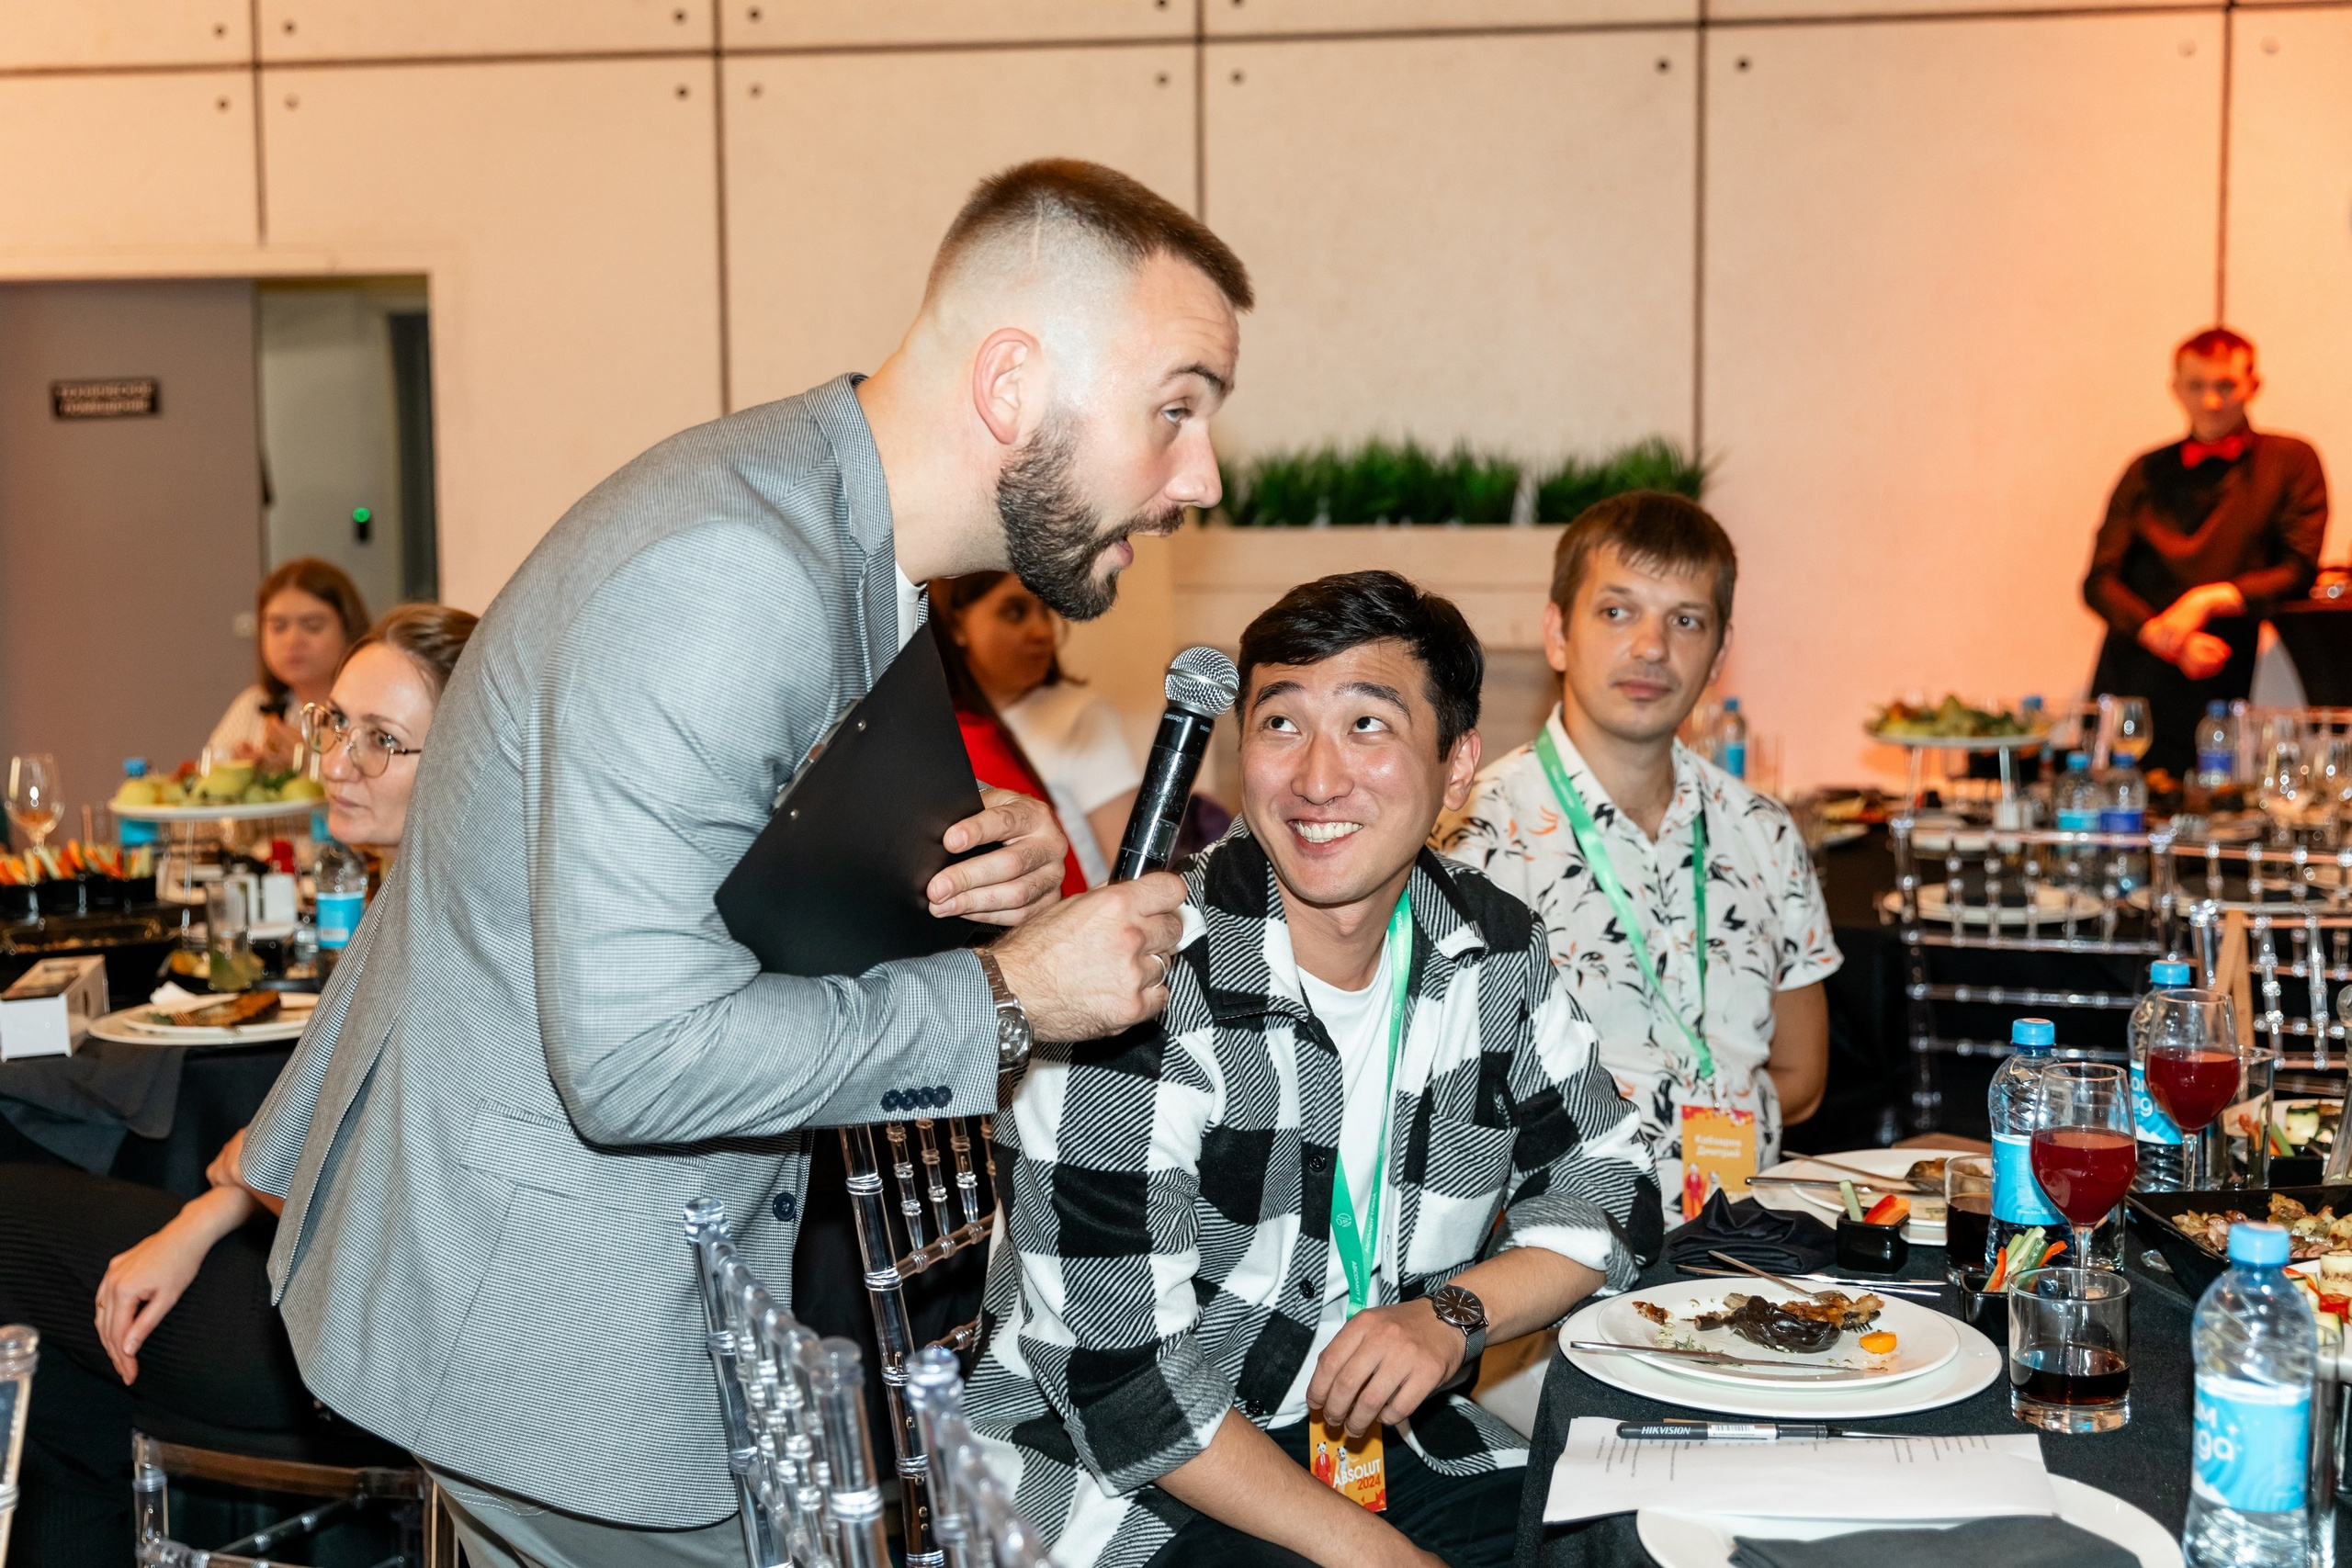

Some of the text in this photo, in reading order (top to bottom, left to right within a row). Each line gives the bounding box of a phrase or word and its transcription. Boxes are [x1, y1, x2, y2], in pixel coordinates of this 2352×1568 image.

[1351, 1260, 1361, 1296] АБСОЛЮТ
[1641, 1426, 1690, 1435] HIKVISION
[1333, 1459, 1380, 1488] ABSOLUT
[1357, 1474, 1381, 1491] 2024
